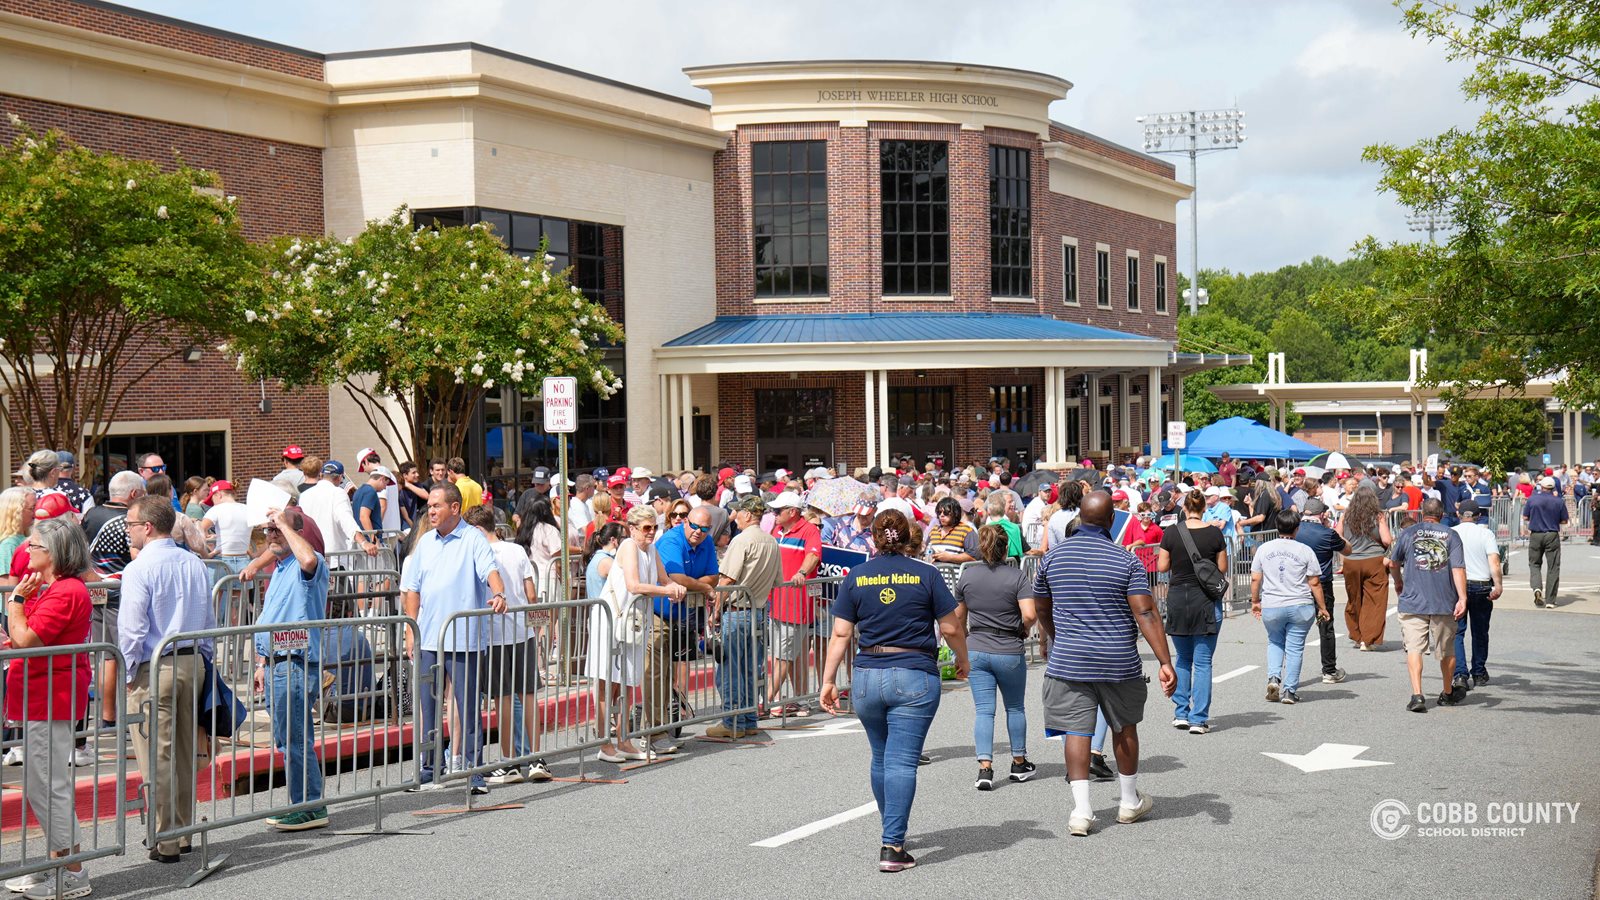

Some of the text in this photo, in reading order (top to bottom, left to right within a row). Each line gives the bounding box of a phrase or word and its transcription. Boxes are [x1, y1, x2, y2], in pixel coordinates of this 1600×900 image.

[817, 90, 999, 107] JOSEPH WHEELER HIGH SCHOOL
[553, 384, 565, 394] NO
[546, 397, 573, 407] PARKING
[553, 409, 566, 417] FIRE
[552, 418, 568, 426] LANE
[856, 574, 889, 587] Wheeler
[891, 573, 921, 585] Nation
[274, 630, 308, 642] NATIONAL
